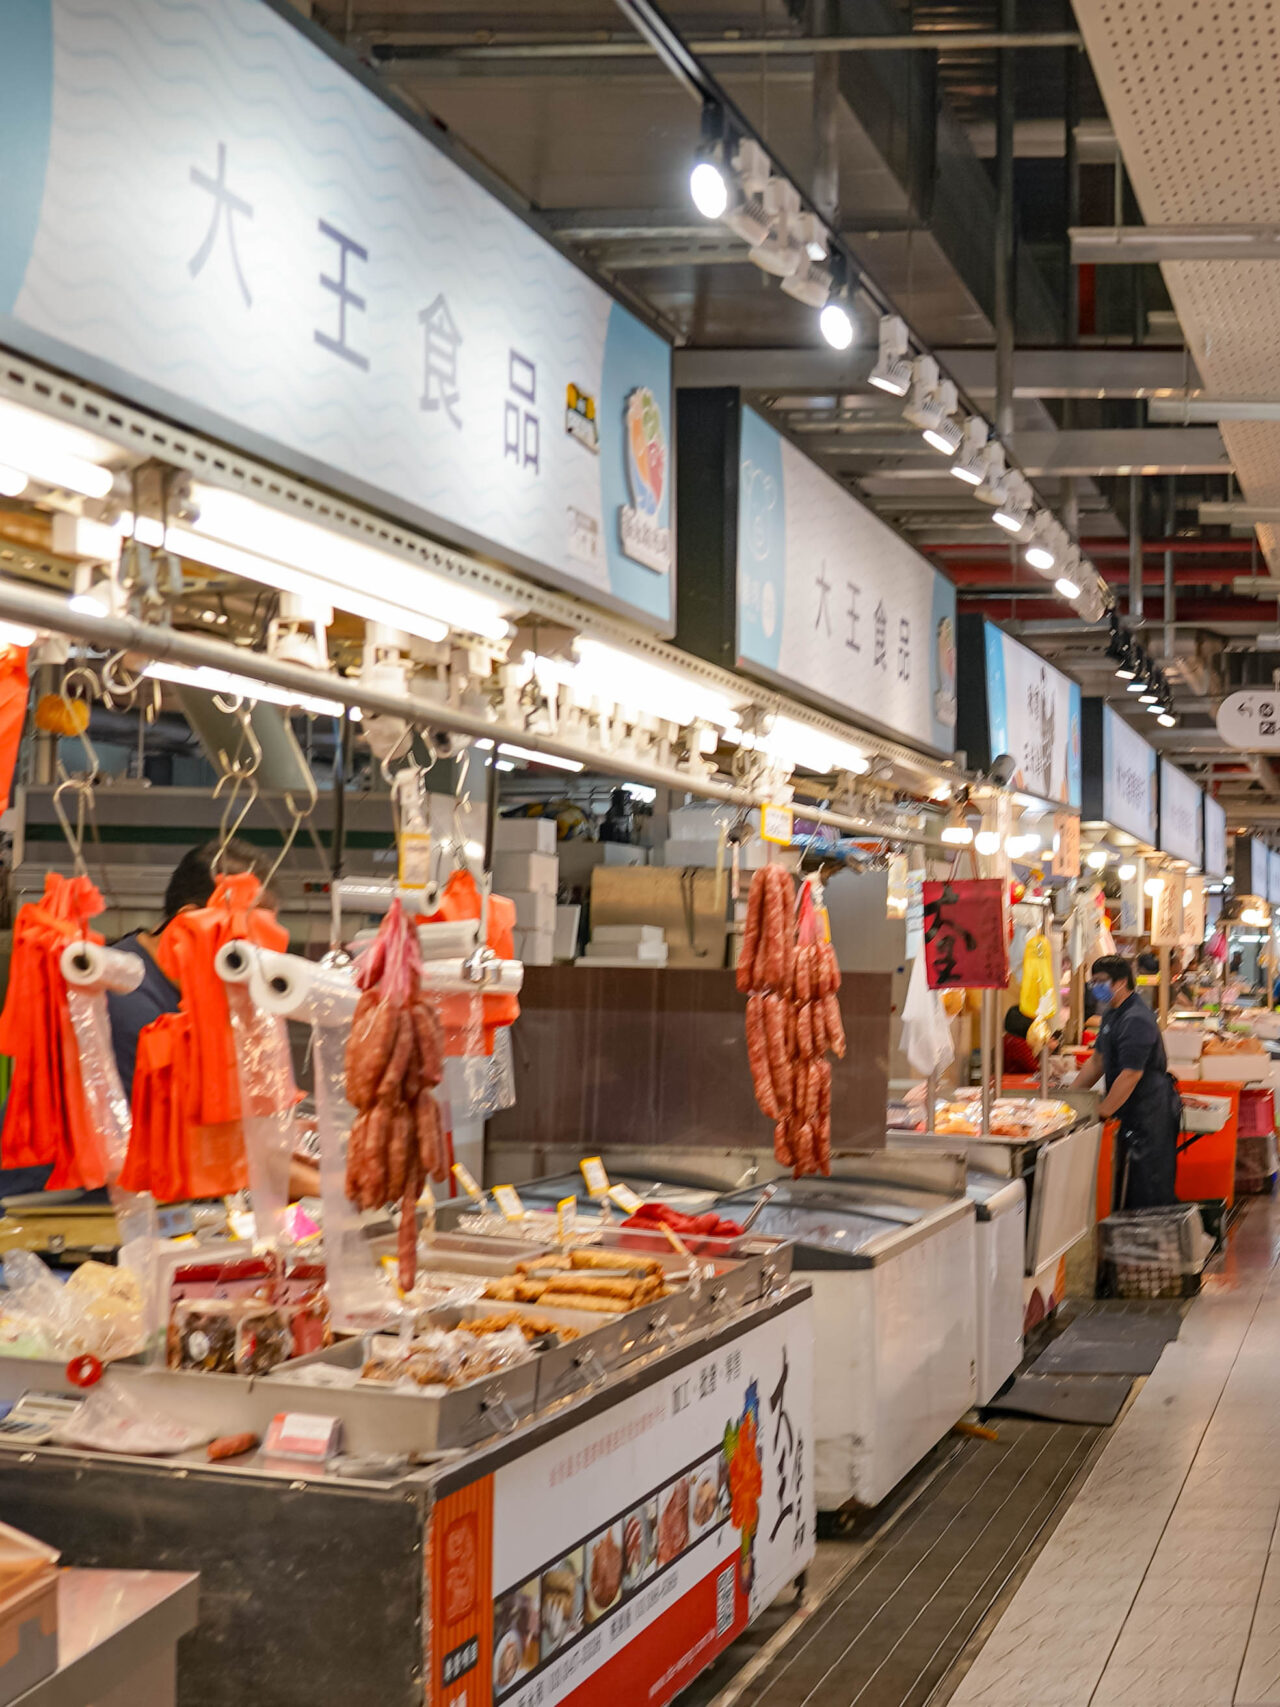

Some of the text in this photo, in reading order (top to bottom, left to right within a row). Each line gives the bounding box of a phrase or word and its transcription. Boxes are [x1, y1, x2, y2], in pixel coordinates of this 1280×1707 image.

[188, 140, 540, 476] 大王食品
[815, 558, 910, 681] 大王食品
